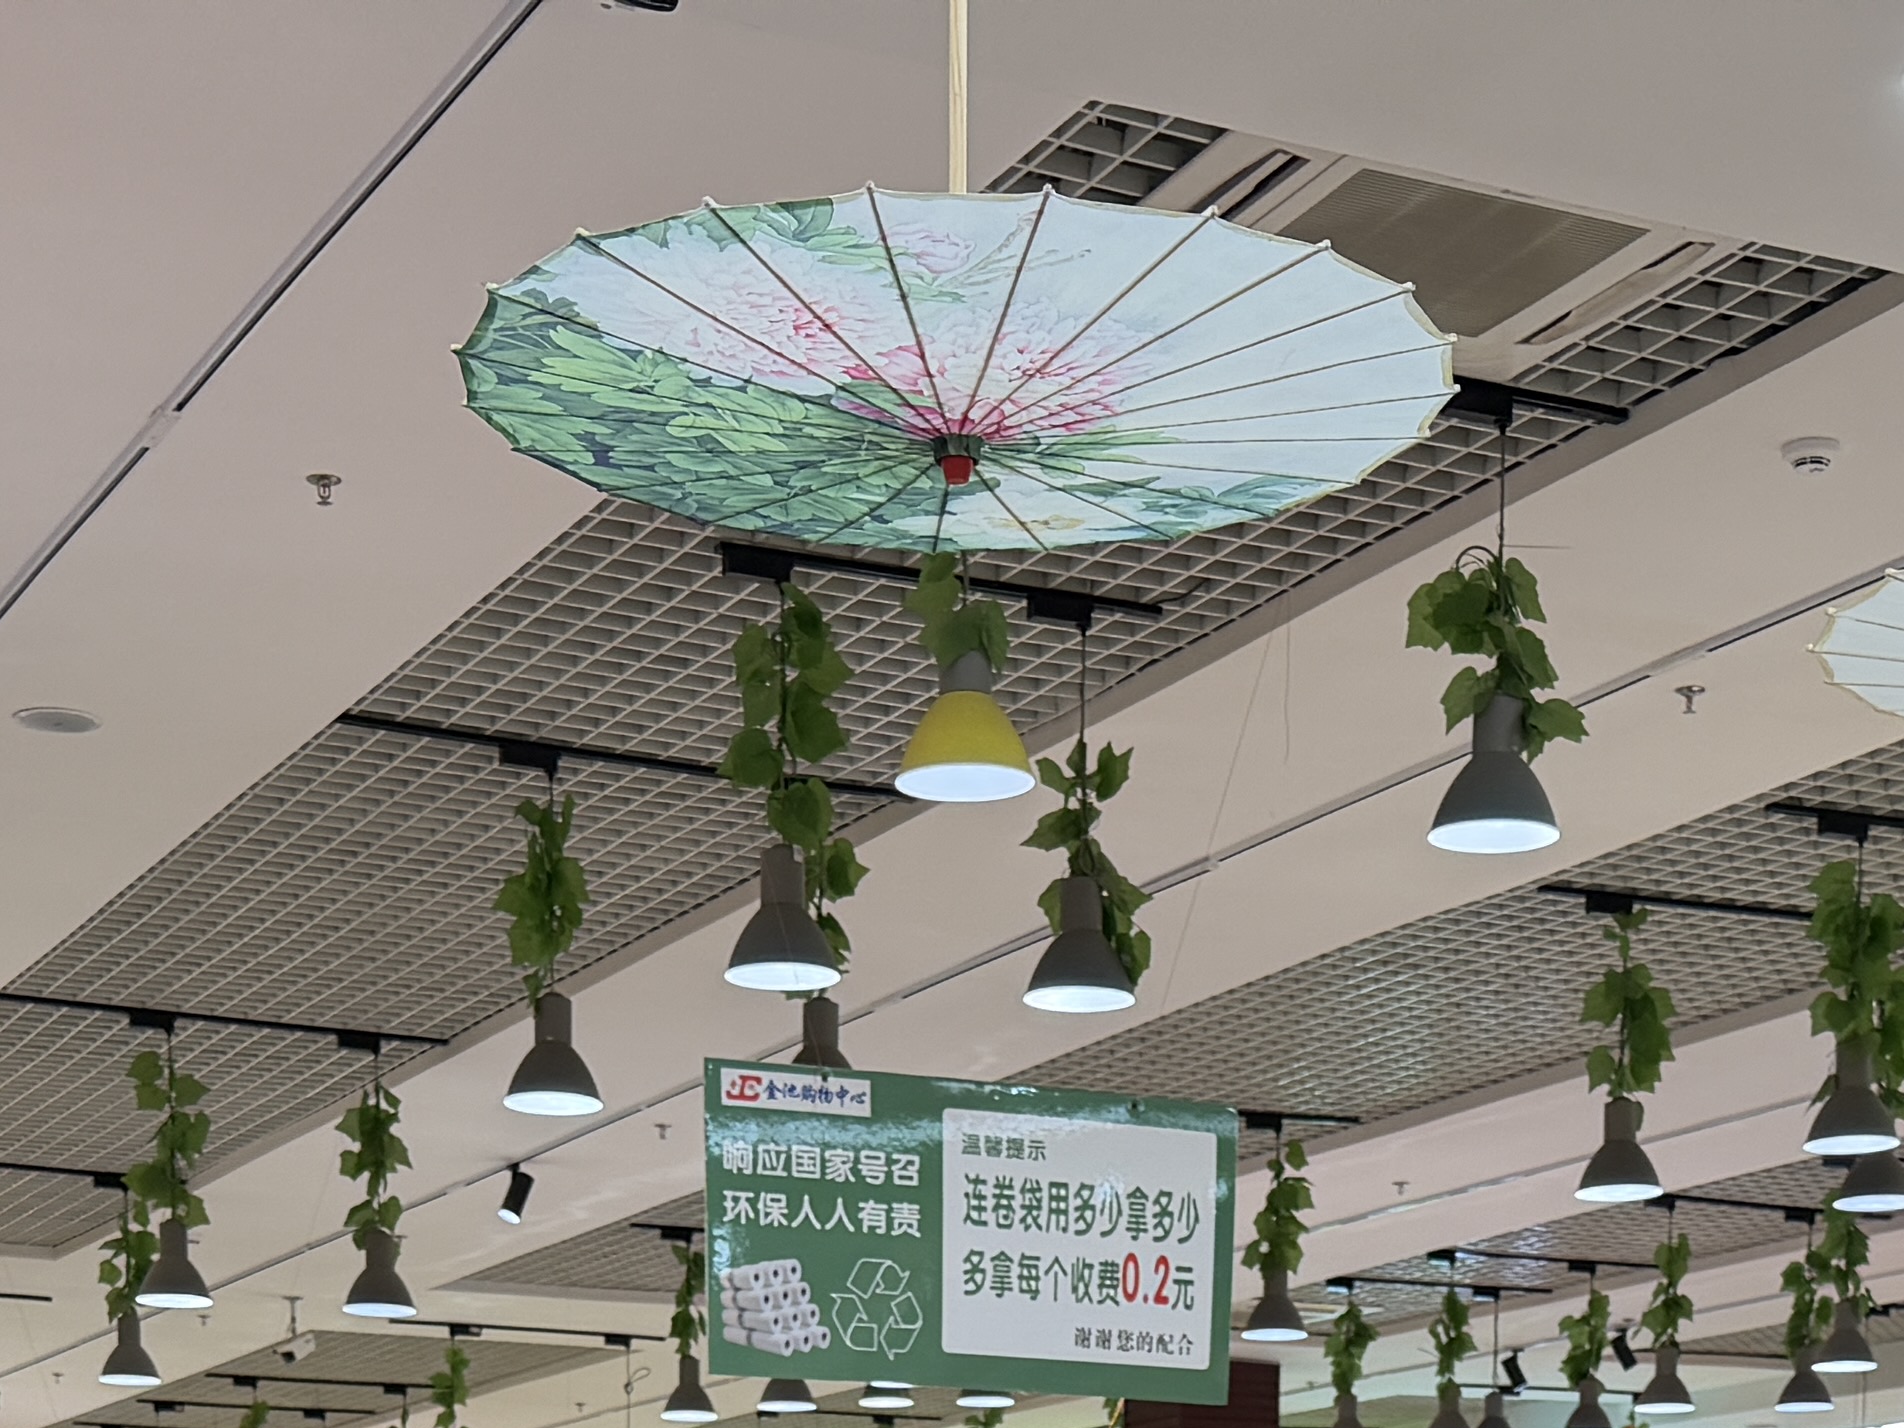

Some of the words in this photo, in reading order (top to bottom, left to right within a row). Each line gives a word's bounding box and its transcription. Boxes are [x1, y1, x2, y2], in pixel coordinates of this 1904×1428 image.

[722, 1140, 921, 1187] 响应国家号召
[961, 1132, 1047, 1163] 温馨提示
[722, 1189, 922, 1239] 环保人人有责
[962, 1172, 1201, 1245] 连卷袋用多少拿多少
[961, 1250, 1197, 1312] 多拿每个收费0.2元
